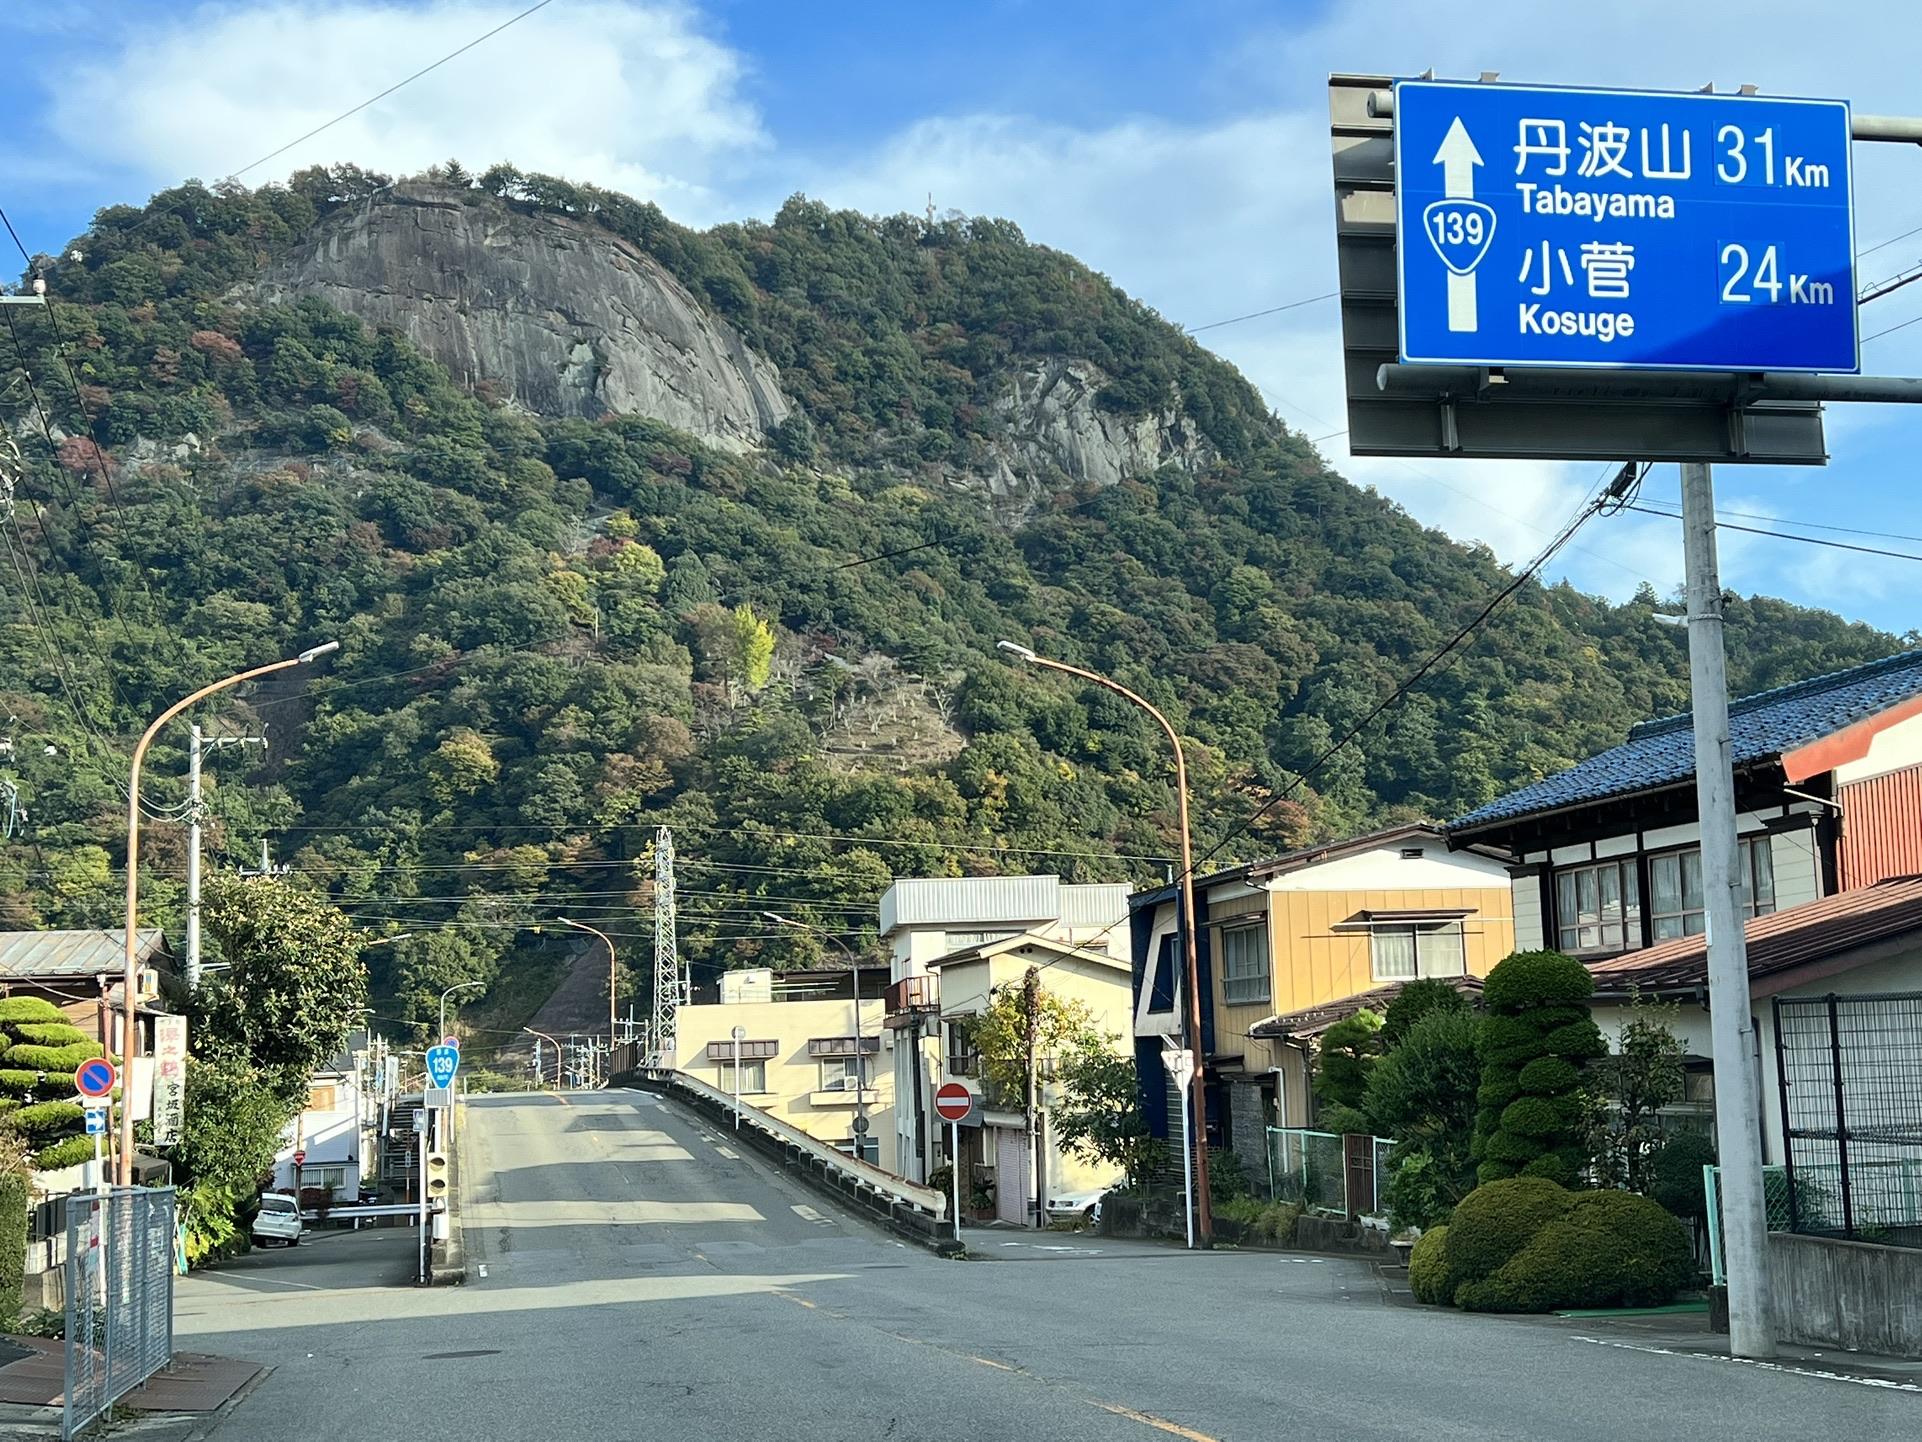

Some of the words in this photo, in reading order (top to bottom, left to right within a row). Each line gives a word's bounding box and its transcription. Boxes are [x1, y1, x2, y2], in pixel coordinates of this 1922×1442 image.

[1513, 118, 1691, 179] 丹波山
[1516, 183, 1675, 222] Tabayama
[1432, 212, 1484, 246] 139
[1518, 240, 1635, 297] 小菅
[1519, 304, 1635, 342] Kosuge
[433, 1057, 453, 1073] 139
